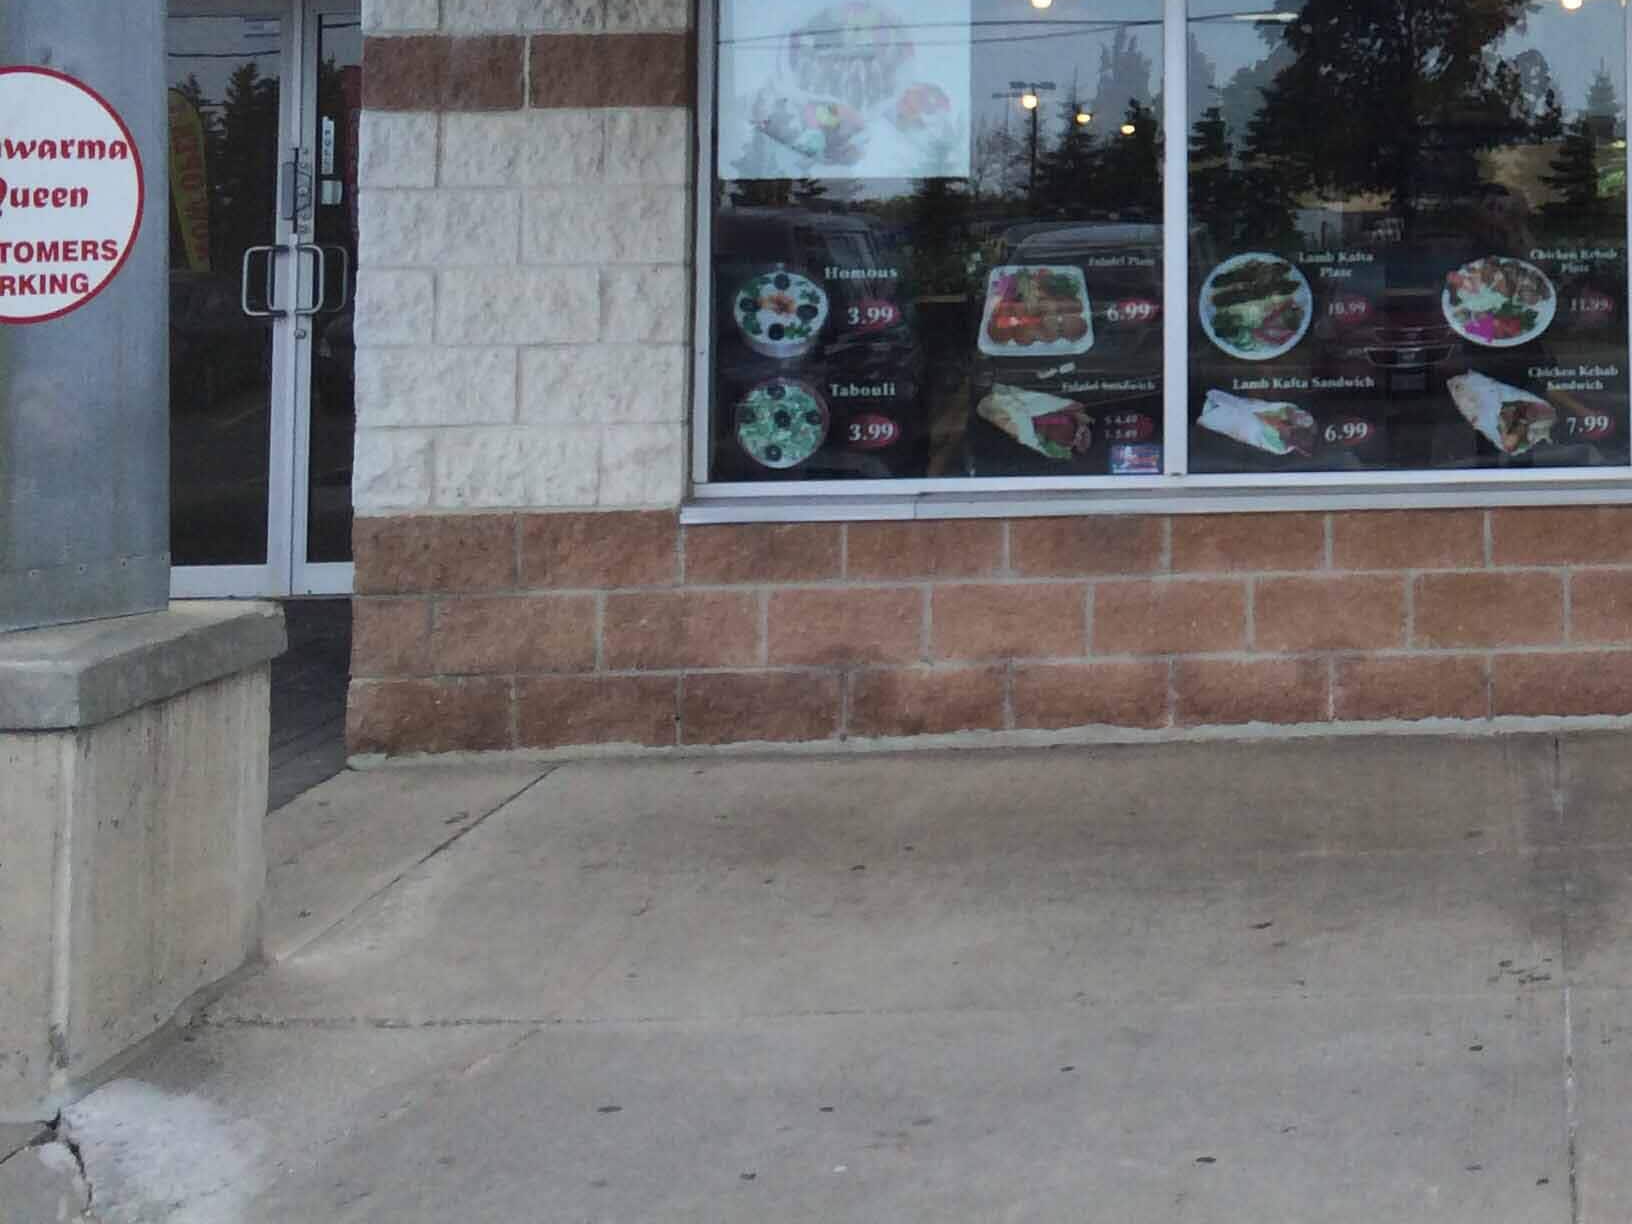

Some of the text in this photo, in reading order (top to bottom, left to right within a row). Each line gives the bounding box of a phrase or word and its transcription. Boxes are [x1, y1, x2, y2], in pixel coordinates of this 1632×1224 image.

[0, 139, 128, 160] warma
[0, 177, 89, 216] ueen
[825, 266, 898, 279] Homous
[848, 305, 894, 325] 3.99
[1106, 302, 1151, 322] 6.99
[830, 382, 896, 397] Tabouli
[1233, 376, 1376, 390] Lamb Kafta Sandwich
[849, 423, 894, 441] 3.99
[1324, 422, 1368, 442] 6.99
[1567, 414, 1609, 435] 7.99
